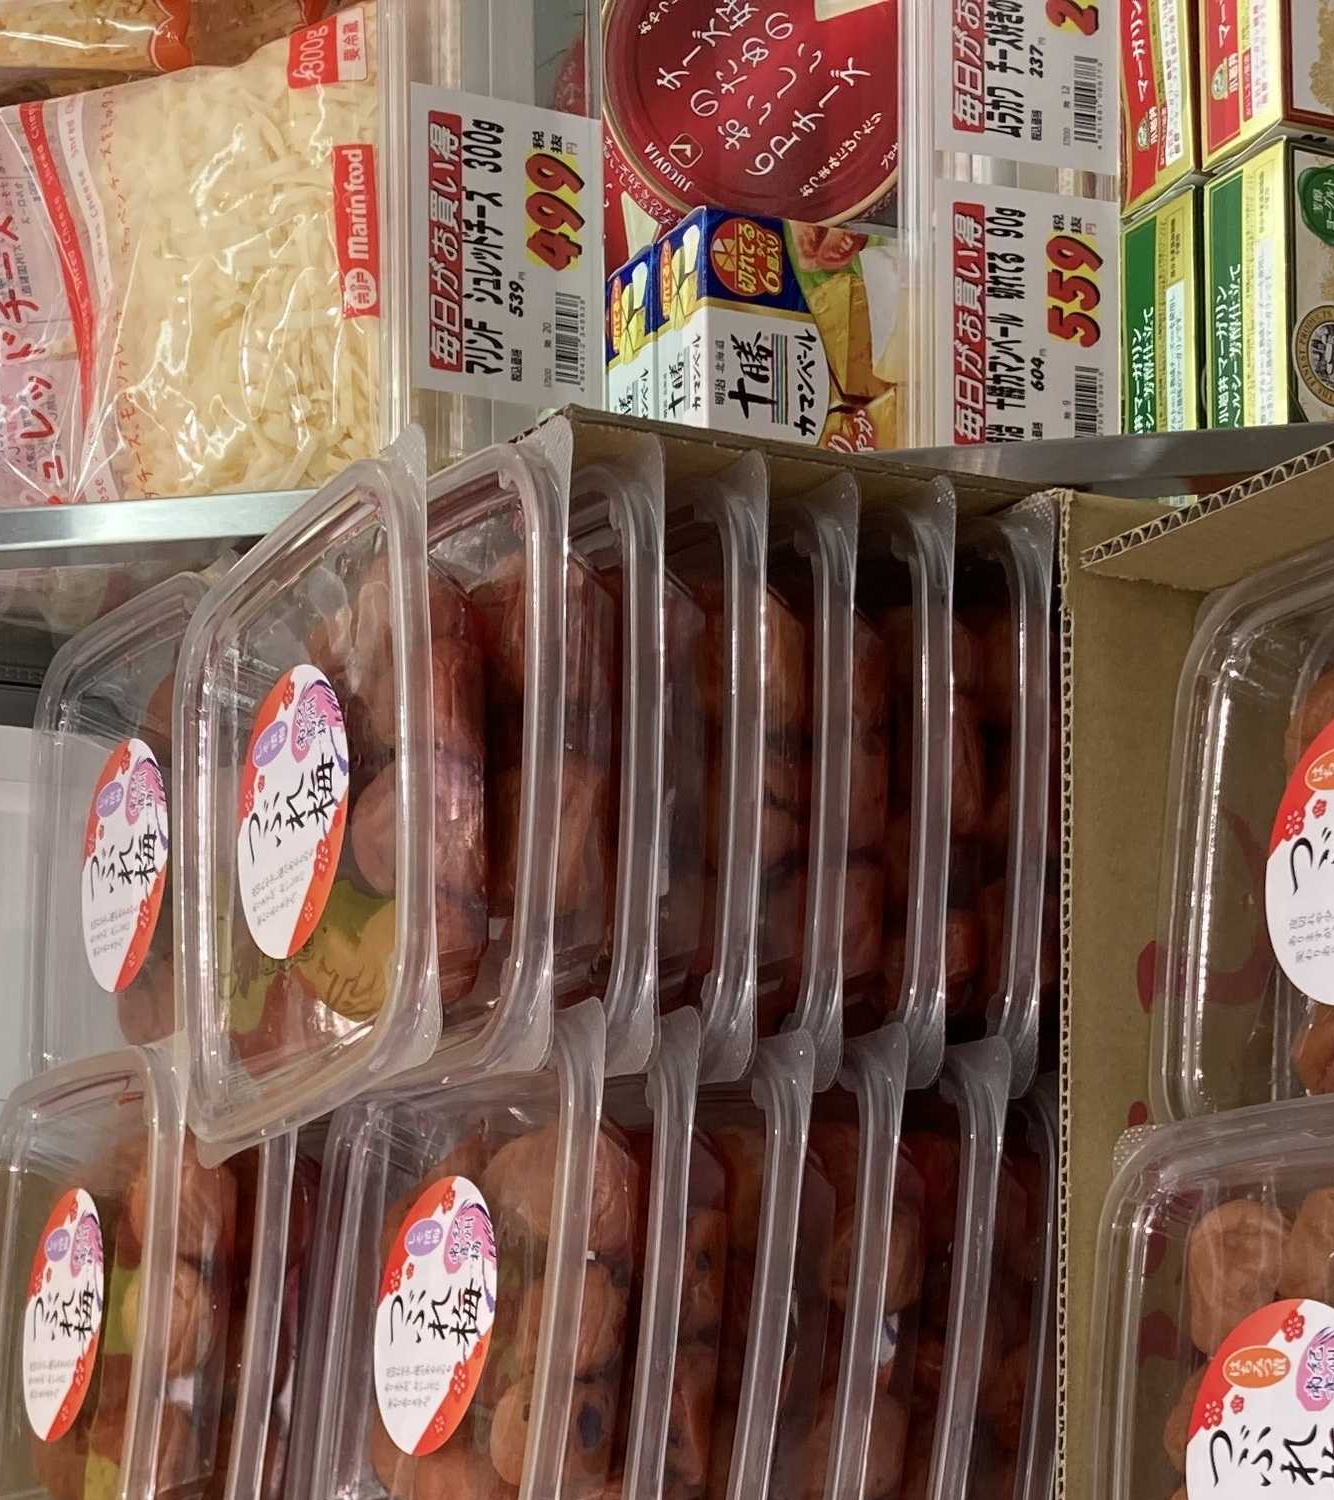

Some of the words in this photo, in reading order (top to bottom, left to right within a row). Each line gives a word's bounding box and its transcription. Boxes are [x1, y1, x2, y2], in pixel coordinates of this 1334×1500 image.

[1029, 44, 1044, 79] 237
[985, 86, 1024, 138] ムラカワ
[342, 149, 366, 191] food
[463, 119, 505, 173] 300g
[643, 141, 695, 193] JUCOVIA
[345, 193, 370, 260] Marin
[428, 122, 461, 366] 毎日がお買い得
[524, 152, 585, 272] 499
[986, 207, 1026, 239] 90g
[463, 191, 505, 306] シュレッドチーズ
[738, 223, 756, 293] 切れてる
[987, 253, 1025, 300] 切れてる
[509, 280, 524, 317] 539
[1046, 235, 1104, 347] 559
[463, 320, 504, 376] マリンF
[953, 213, 984, 440] 毎日がお買い得
[727, 331, 777, 419] 十勝
[793, 329, 817, 436] カマンベール
[987, 313, 1025, 410] 十勝カマンベール
[1030, 356, 1045, 392] 604
[247, 751, 336, 865] つぶれ梅
[389, 1278, 483, 1346] つぶれ梅
